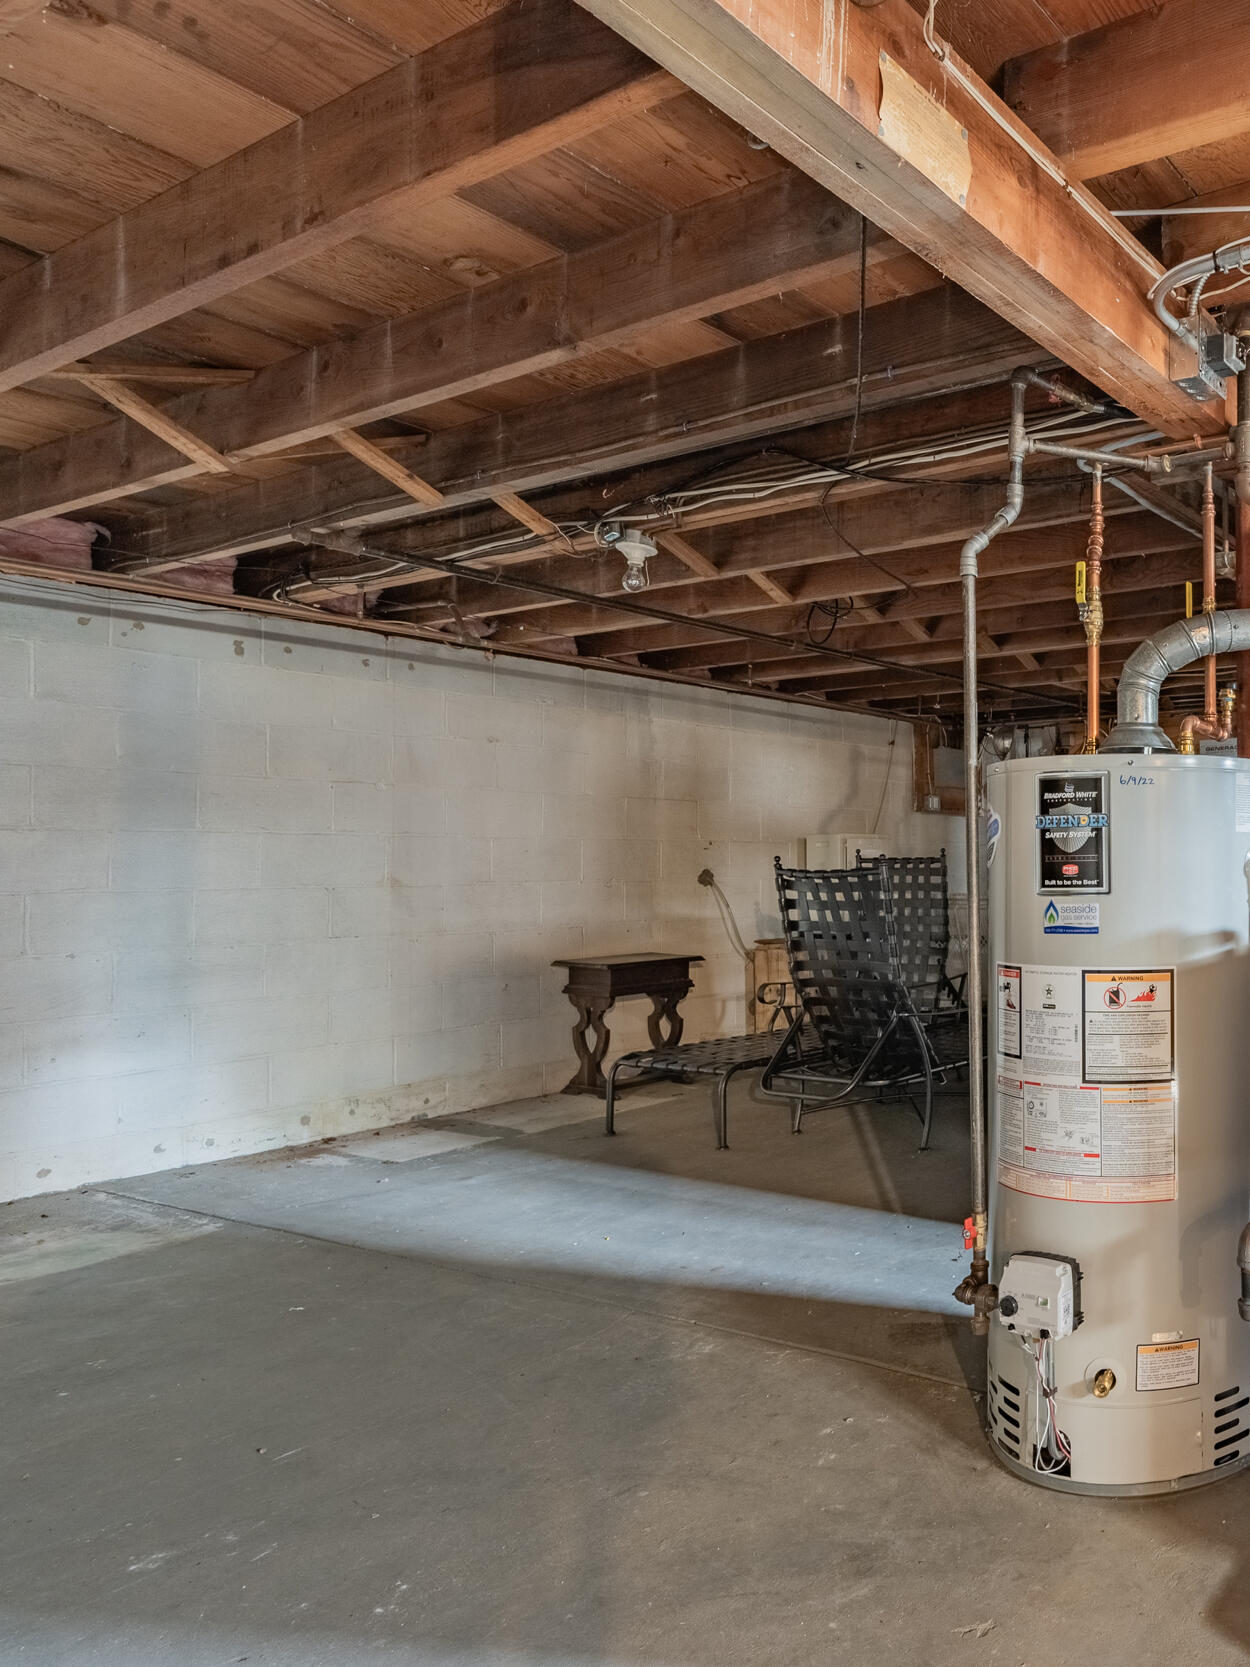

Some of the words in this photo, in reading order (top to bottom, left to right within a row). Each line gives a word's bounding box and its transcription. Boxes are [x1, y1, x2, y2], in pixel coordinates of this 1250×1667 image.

[1119, 775, 1155, 785] 6/9/22
[1036, 813, 1109, 829] DEFENDER
[1045, 831, 1069, 839] SAFETY
[1060, 903, 1097, 914] seaside
[1159, 1344, 1184, 1352] WARNING
